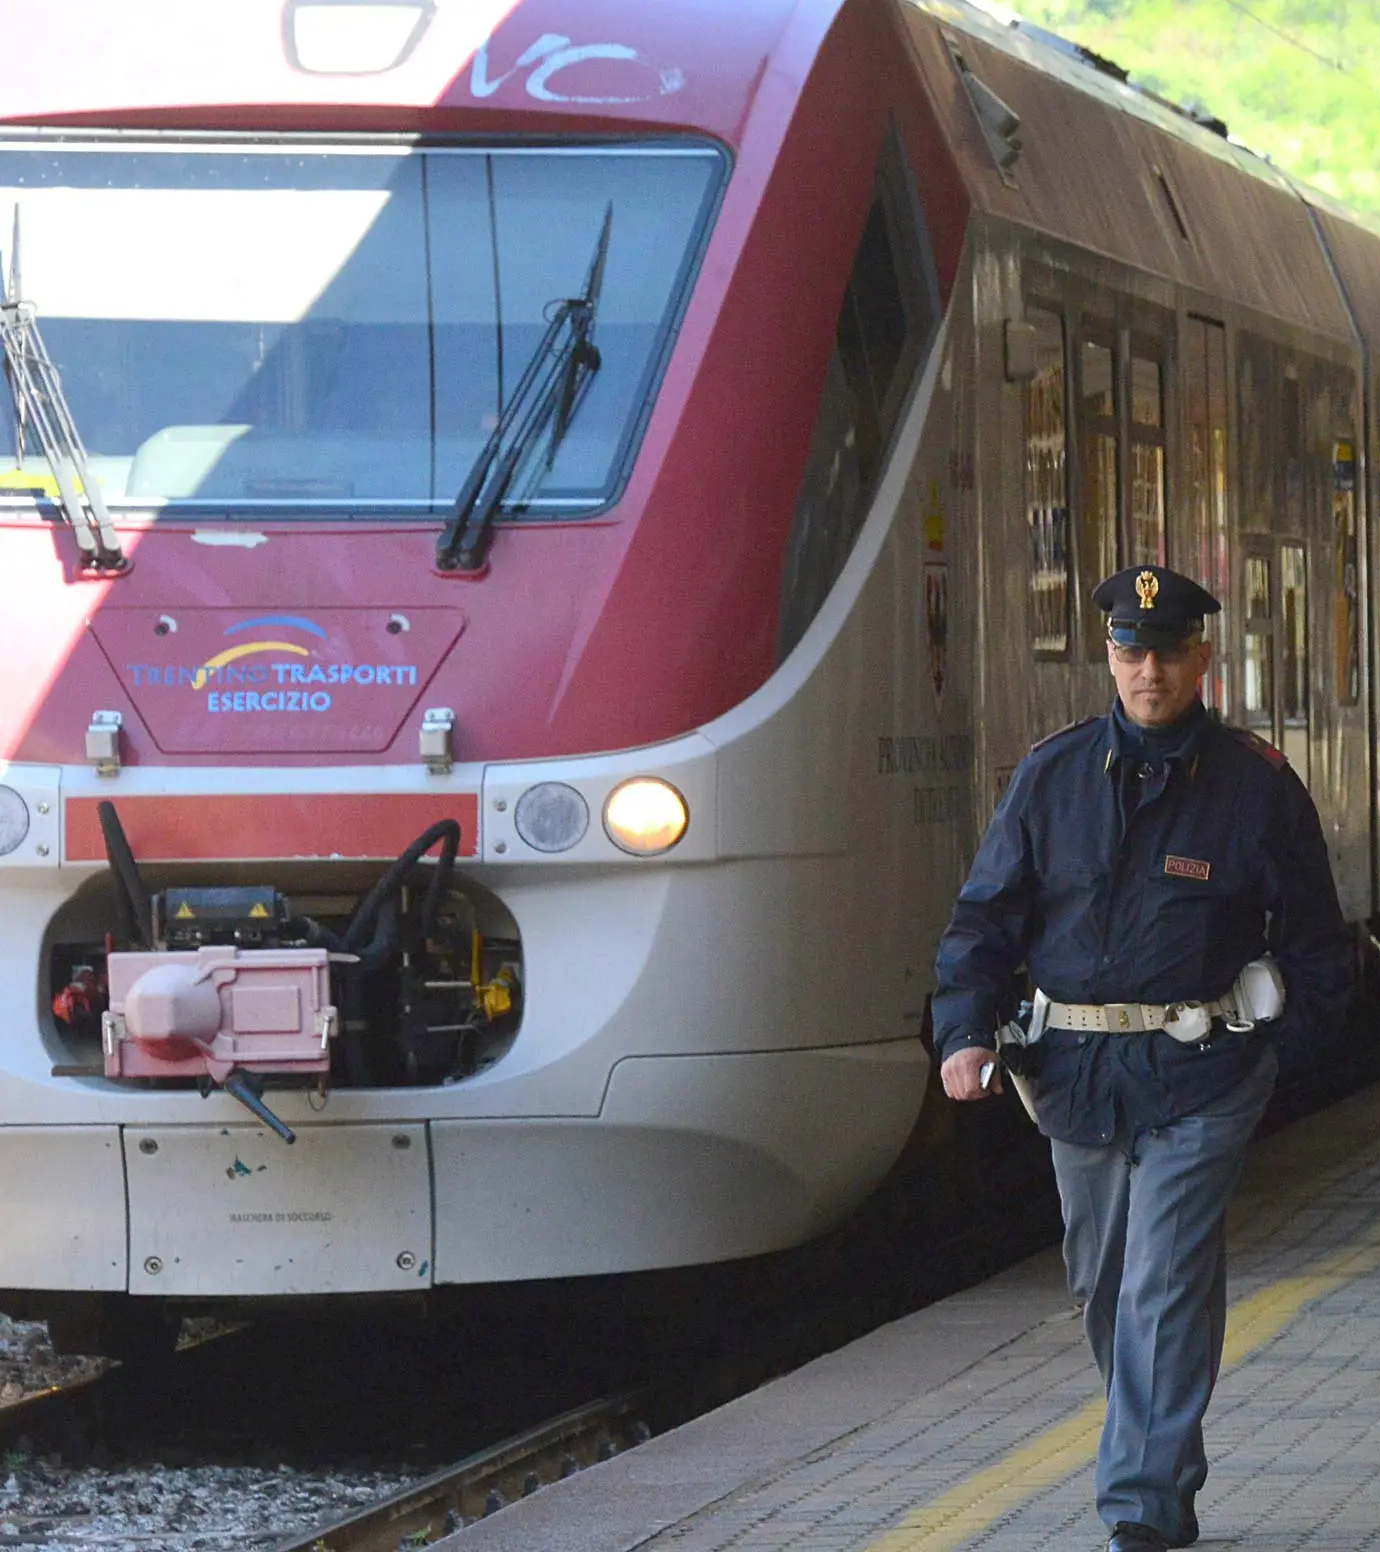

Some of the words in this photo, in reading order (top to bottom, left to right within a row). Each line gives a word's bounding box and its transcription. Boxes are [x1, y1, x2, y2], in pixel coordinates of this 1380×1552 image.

[271, 663, 418, 685] TRASPORTI
[207, 691, 332, 713] ESERCIZIO
[1168, 859, 1207, 877] POLIZIA
